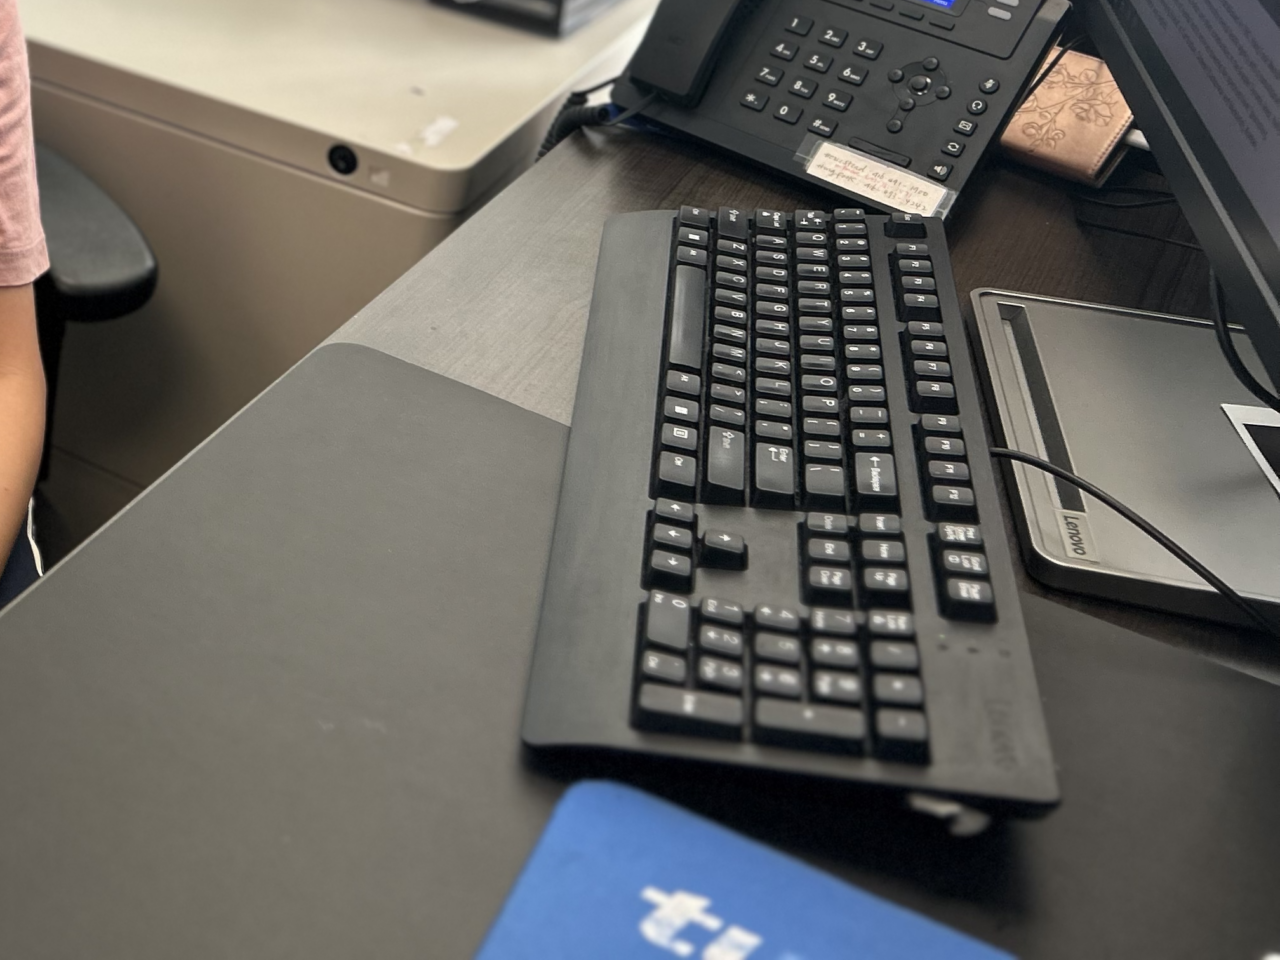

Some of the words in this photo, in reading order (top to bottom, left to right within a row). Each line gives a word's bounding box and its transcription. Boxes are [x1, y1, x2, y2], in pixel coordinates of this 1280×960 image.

[792, 18, 798, 27] 1
[824, 30, 833, 39] 2
[776, 44, 785, 52] 4
[858, 42, 866, 51] 3
[810, 55, 819, 64] 5
[760, 68, 769, 76] 7
[843, 68, 851, 77] 6
[794, 81, 802, 90] 8
[828, 93, 836, 102] 9
[780, 106, 788, 114] 0
[813, 250, 824, 258] W
[774, 323, 786, 331] H
[731, 329, 744, 338] N
[730, 349, 743, 358] M
[928, 363, 937, 371] F7
[820, 378, 834, 386] O
[822, 399, 835, 407] P
[1064, 516, 1086, 556] Lenovo
[672, 599, 687, 609] 0
[779, 610, 794, 619] 4
[723, 634, 738, 645] 2
[778, 641, 795, 650] 5
[722, 667, 739, 677] 3
